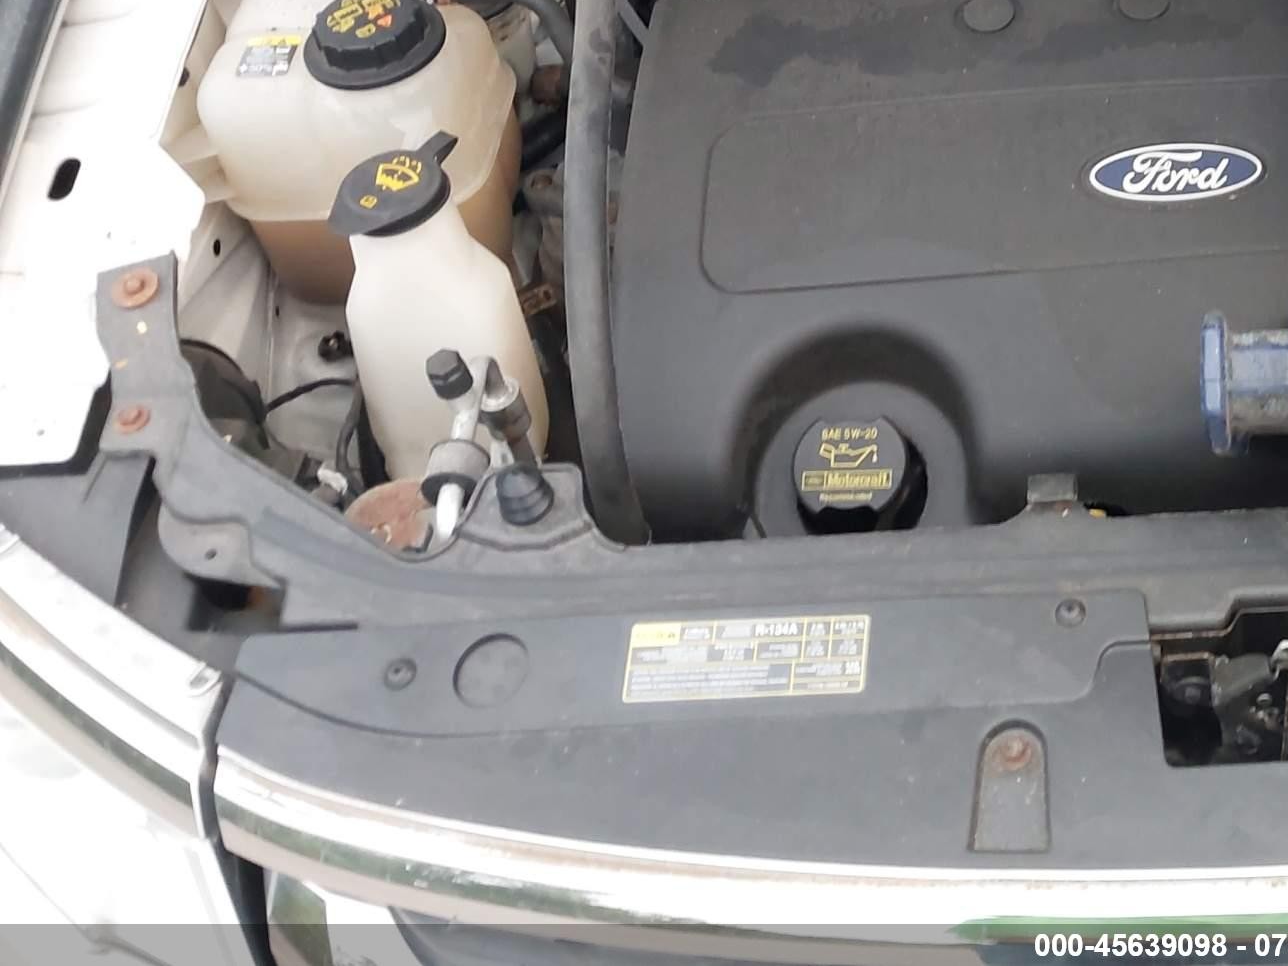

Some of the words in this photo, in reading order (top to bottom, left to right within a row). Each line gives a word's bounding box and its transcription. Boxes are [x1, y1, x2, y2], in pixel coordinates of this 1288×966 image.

[1122, 150, 1230, 194] Ford
[822, 427, 842, 441] SAE
[844, 426, 878, 440] 5W-20
[827, 470, 887, 488] Motorcraft
